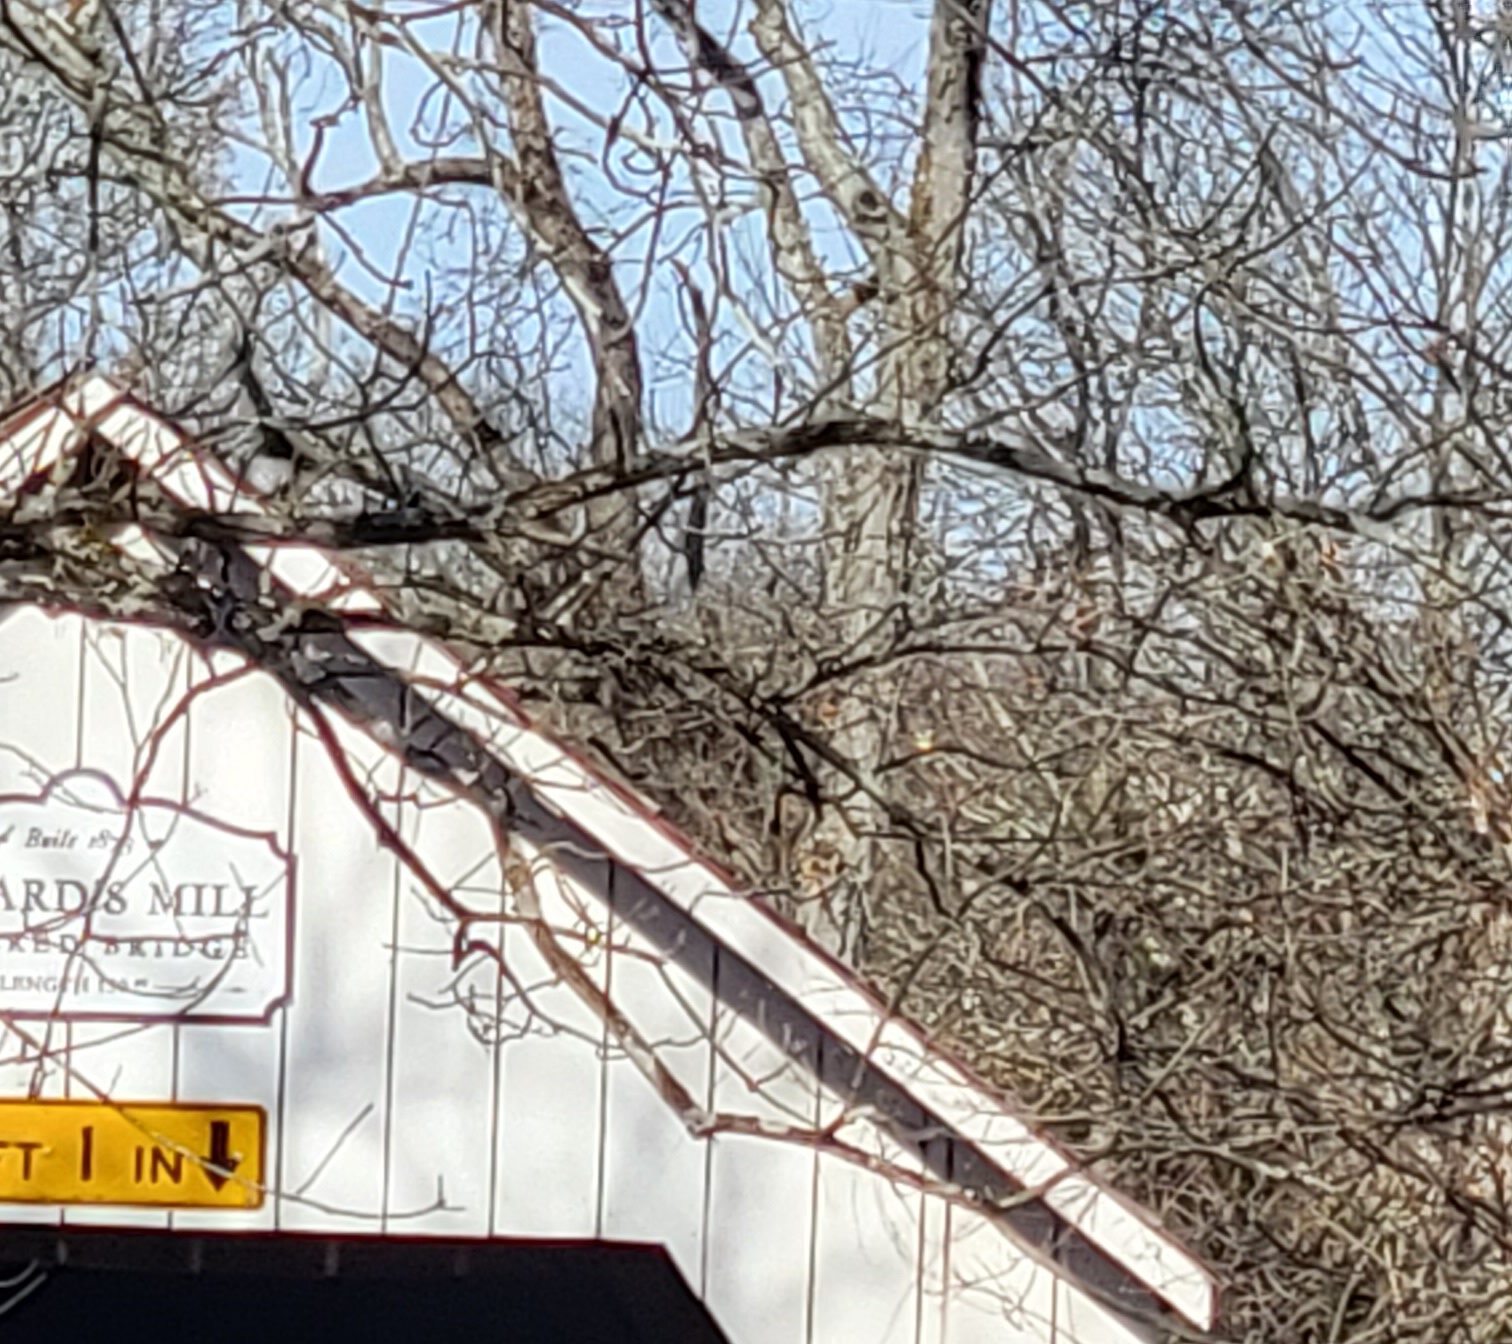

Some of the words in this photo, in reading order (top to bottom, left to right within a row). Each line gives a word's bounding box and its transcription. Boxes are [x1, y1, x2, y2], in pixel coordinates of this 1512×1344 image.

[148, 882, 269, 919] MILL
[80, 1126, 94, 1182] 1
[134, 1145, 184, 1184] IN
